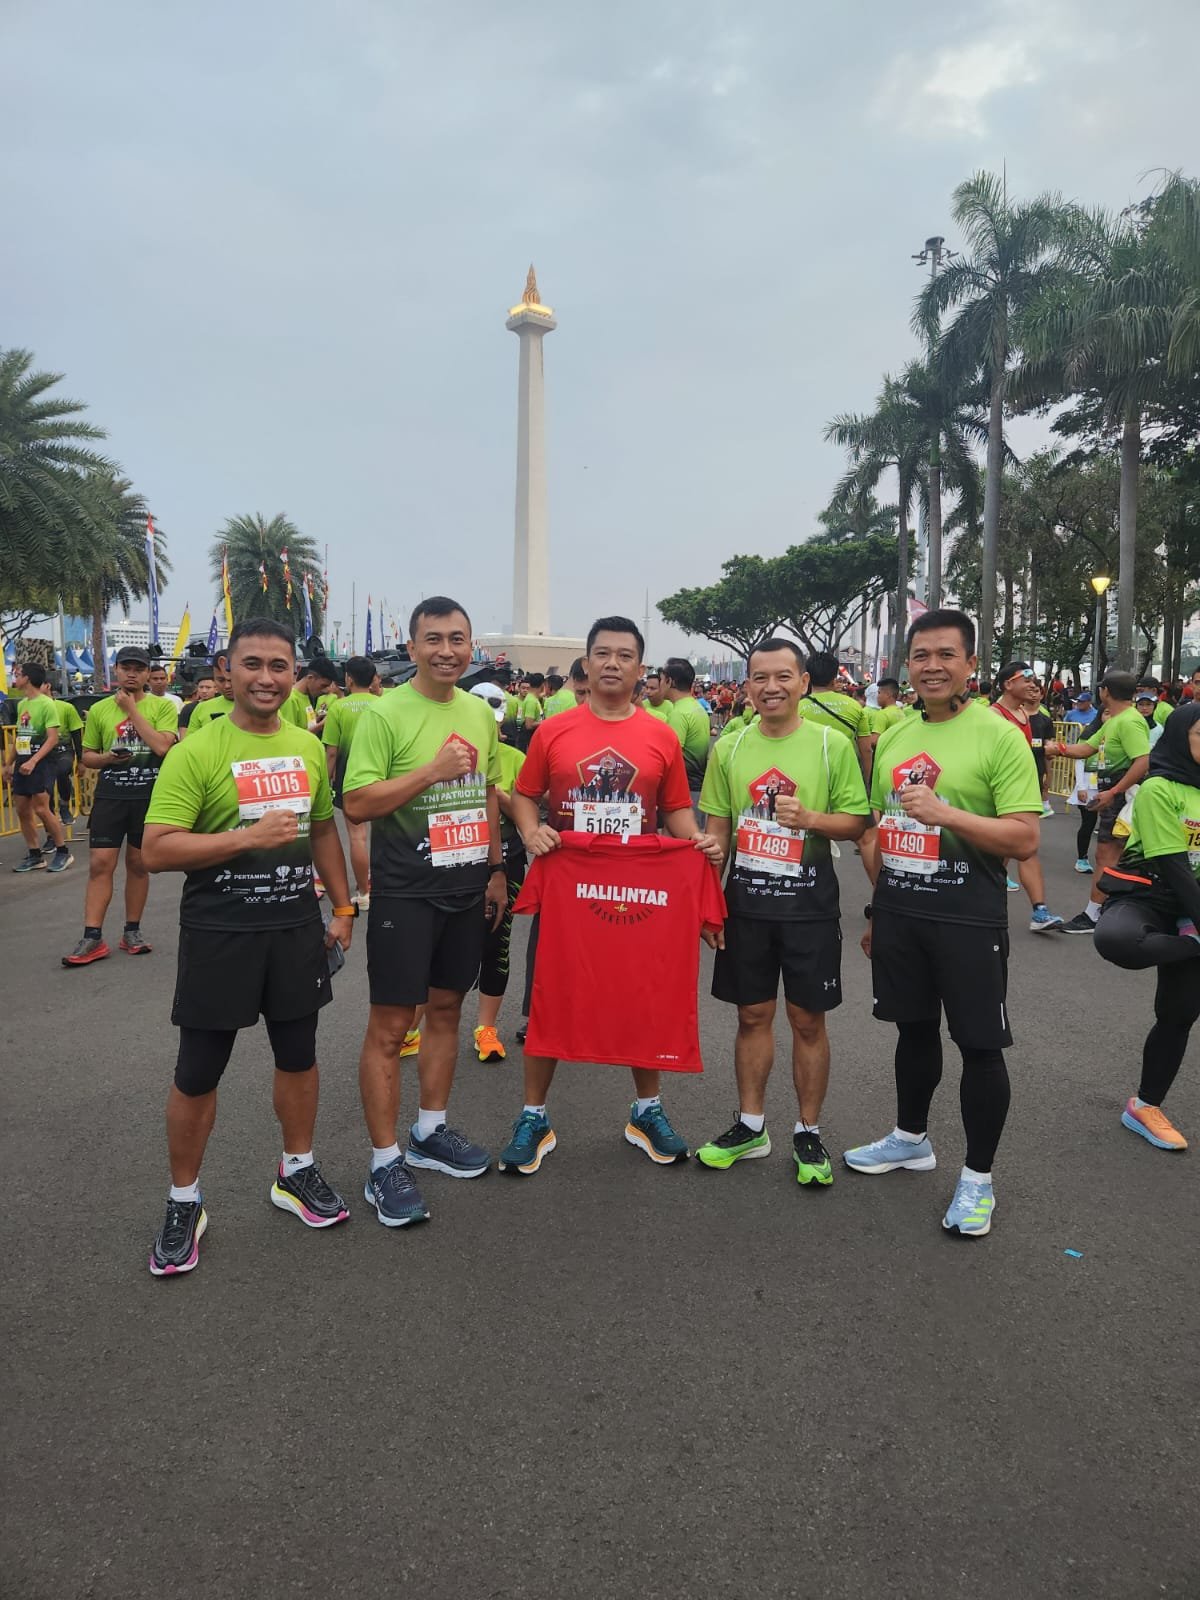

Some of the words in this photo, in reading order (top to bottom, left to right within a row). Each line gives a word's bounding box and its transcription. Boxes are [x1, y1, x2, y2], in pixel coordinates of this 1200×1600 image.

[239, 761, 261, 771] 10K
[252, 773, 300, 797] 11015
[421, 795, 439, 803] TNI
[440, 789, 476, 801] PATRIOT
[581, 803, 596, 811] 5K
[435, 814, 452, 823] 10K
[743, 818, 760, 828] 10K
[444, 824, 480, 846] 11491
[747, 833, 790, 857] 11489
[886, 831, 925, 854] 11490
[576, 883, 668, 907] HALILINTAR
[588, 902, 654, 926] BASKETBALL
